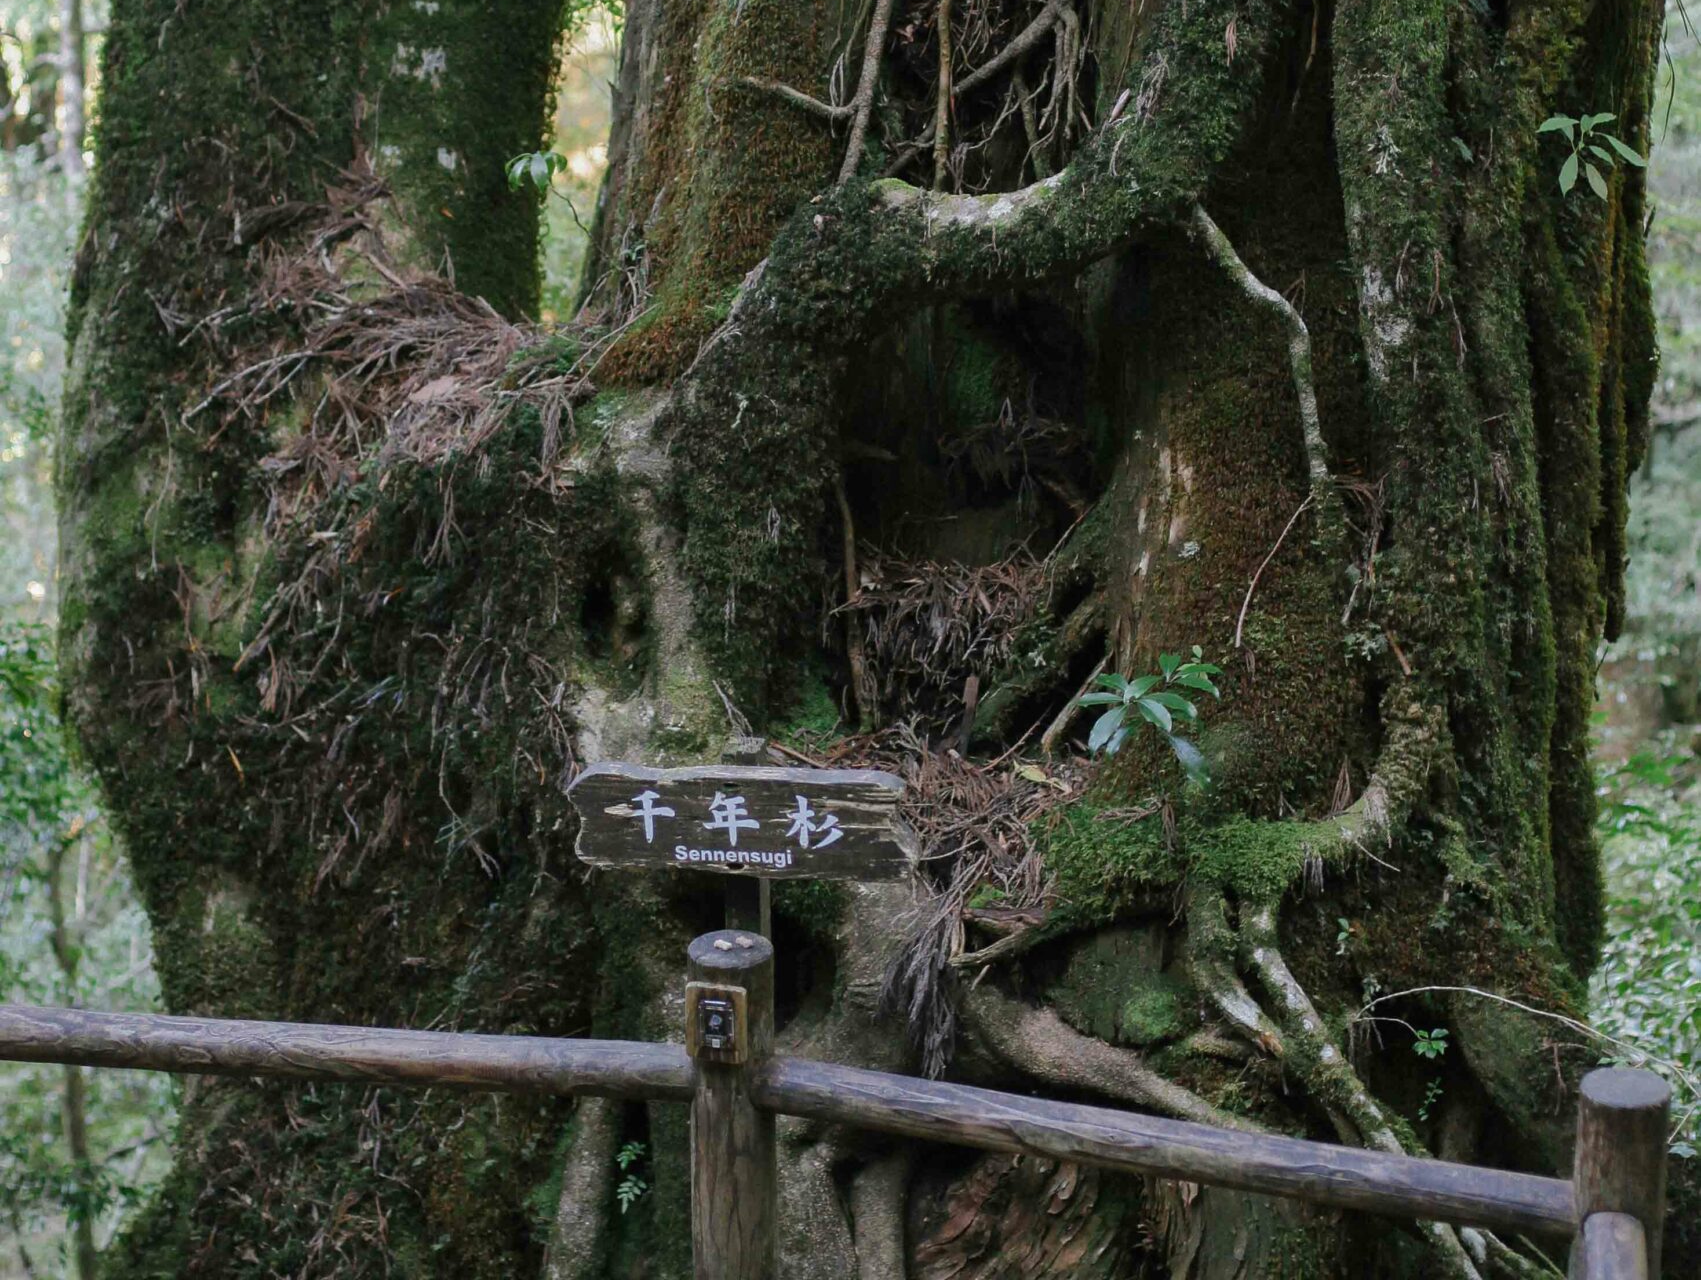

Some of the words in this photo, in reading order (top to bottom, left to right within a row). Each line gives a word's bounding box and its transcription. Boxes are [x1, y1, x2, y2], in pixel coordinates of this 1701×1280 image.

[631, 790, 844, 849] 千年杉
[675, 845, 793, 868] Sennensugi
